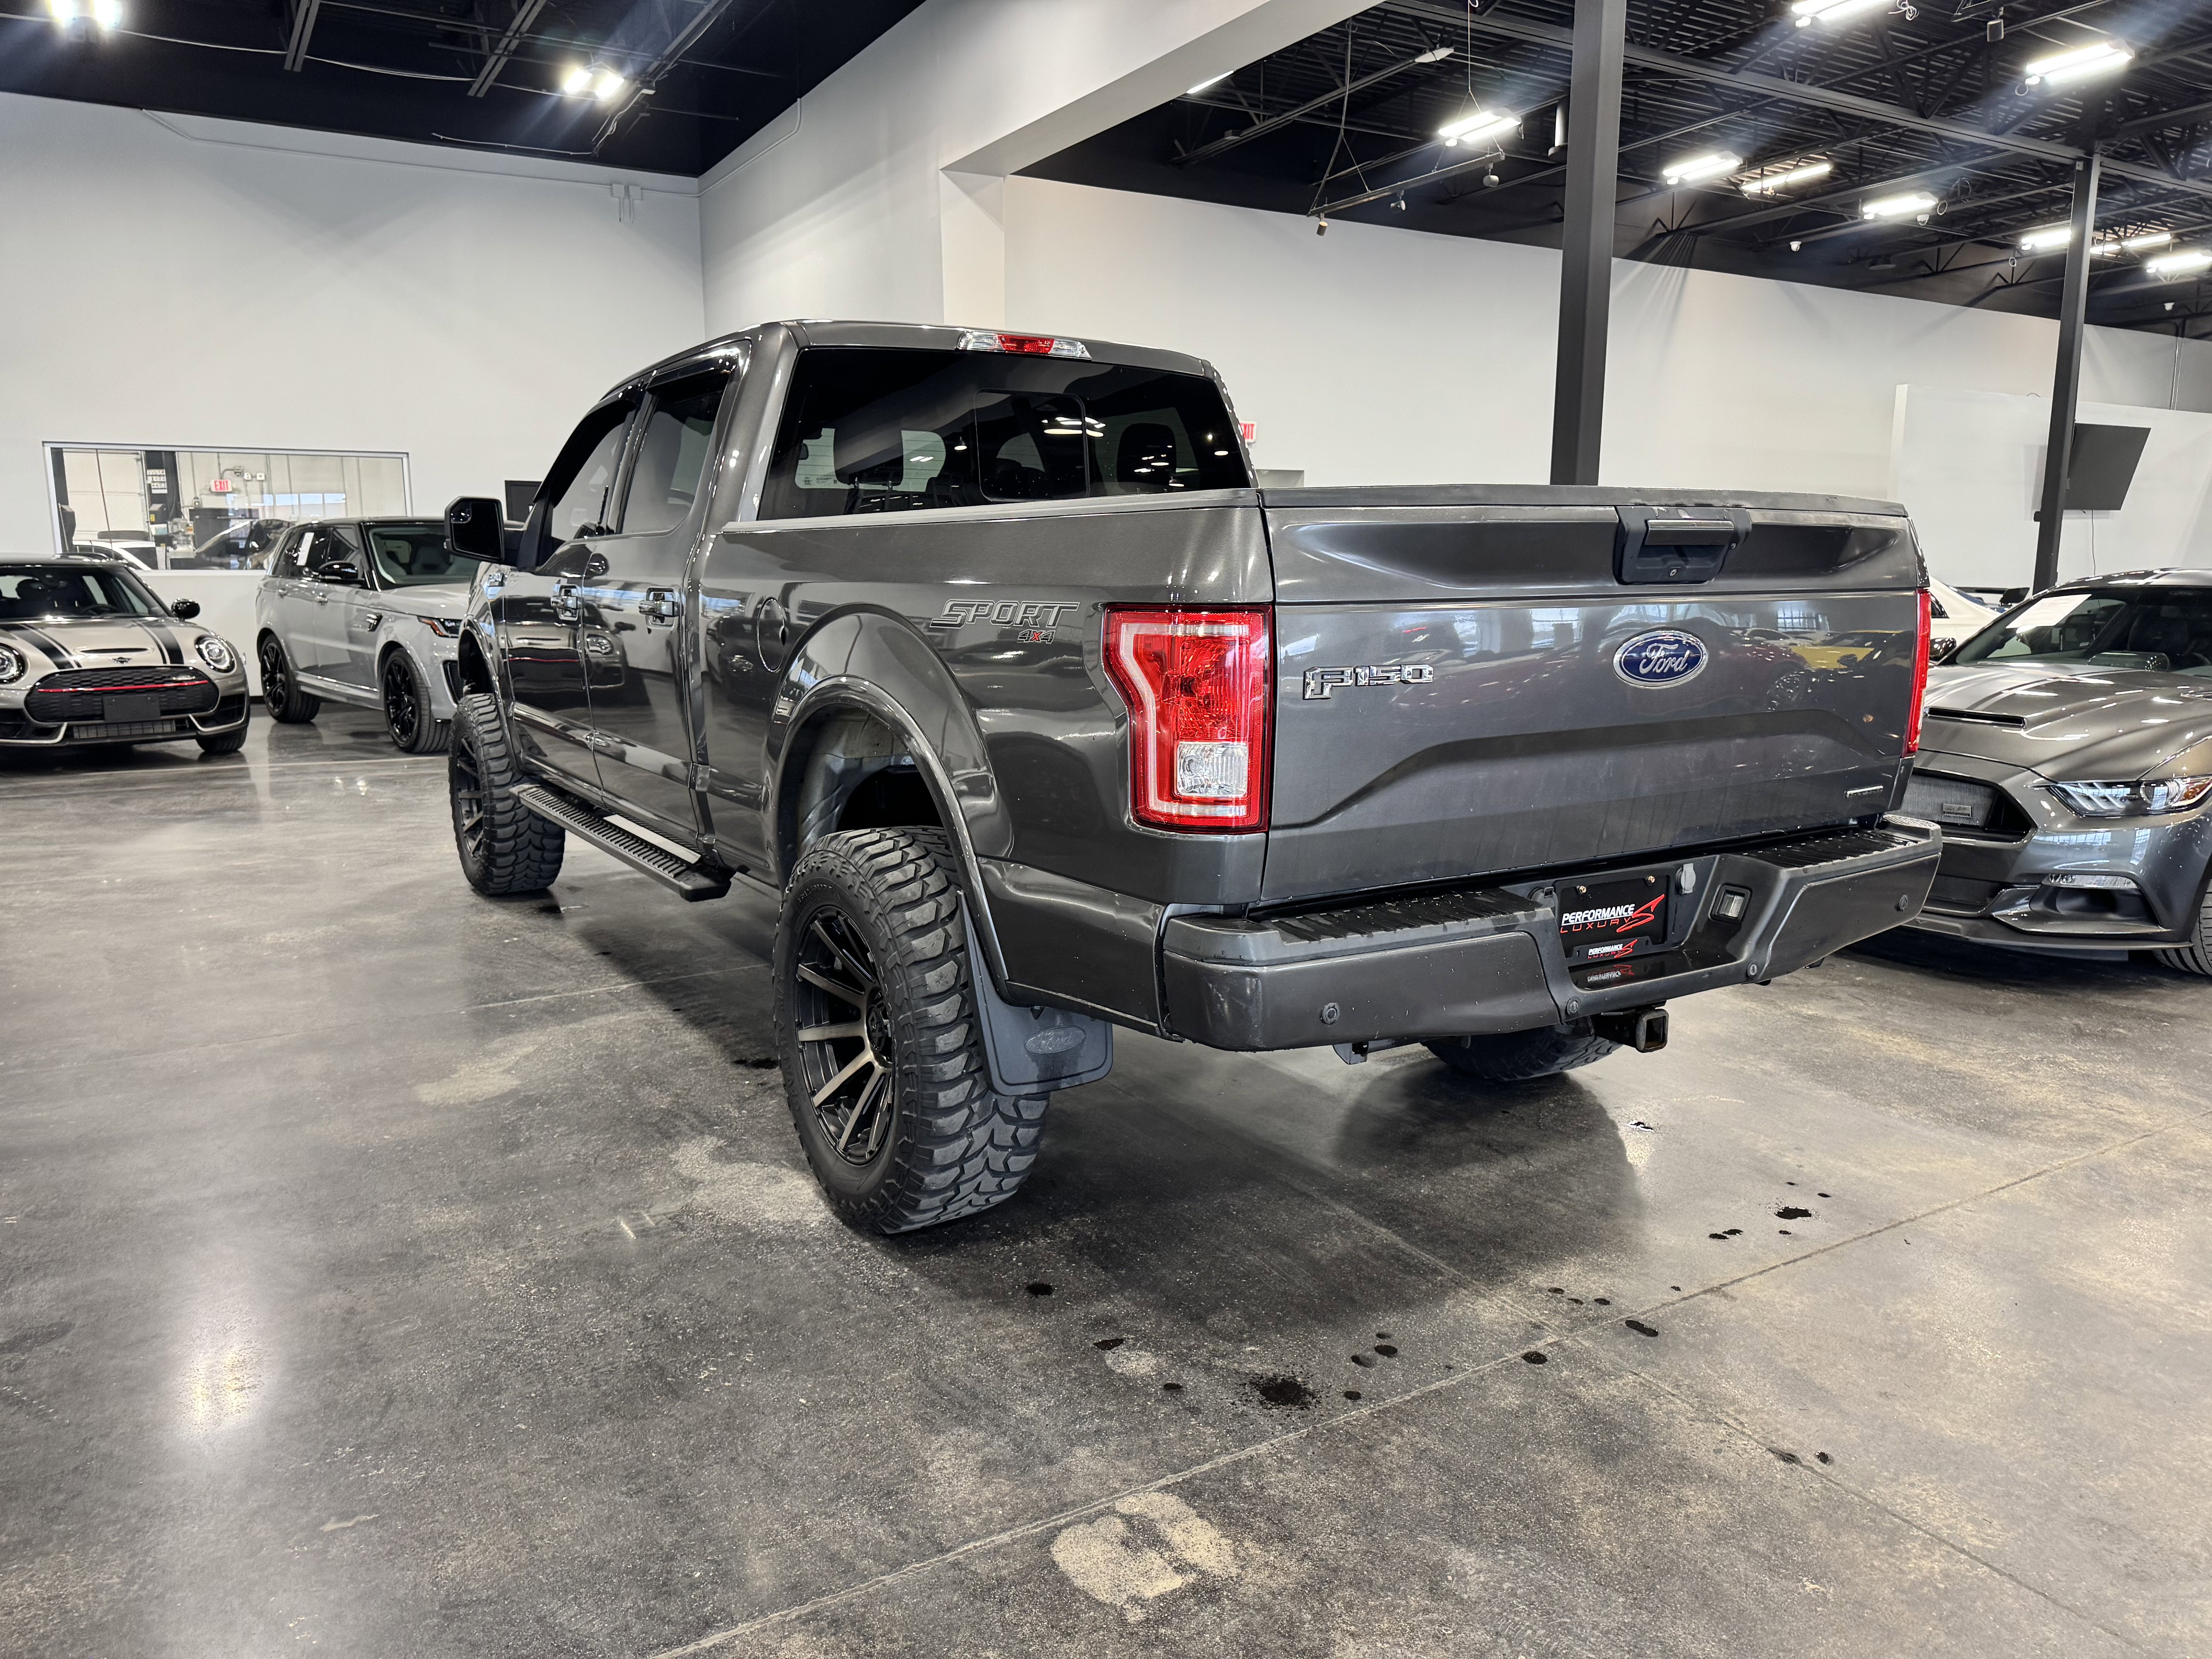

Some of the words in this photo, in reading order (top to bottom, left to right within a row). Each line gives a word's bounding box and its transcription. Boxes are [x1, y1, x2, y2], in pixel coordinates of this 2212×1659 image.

[214, 480, 228, 490] EXIT
[929, 599, 1080, 629] SPORT
[1639, 643, 1691, 674] Ford
[1560, 916, 1631, 933] LUXURY
[1561, 903, 1635, 926] PERFORMANCE
[1588, 943, 1623, 955] PERFORMANCE
